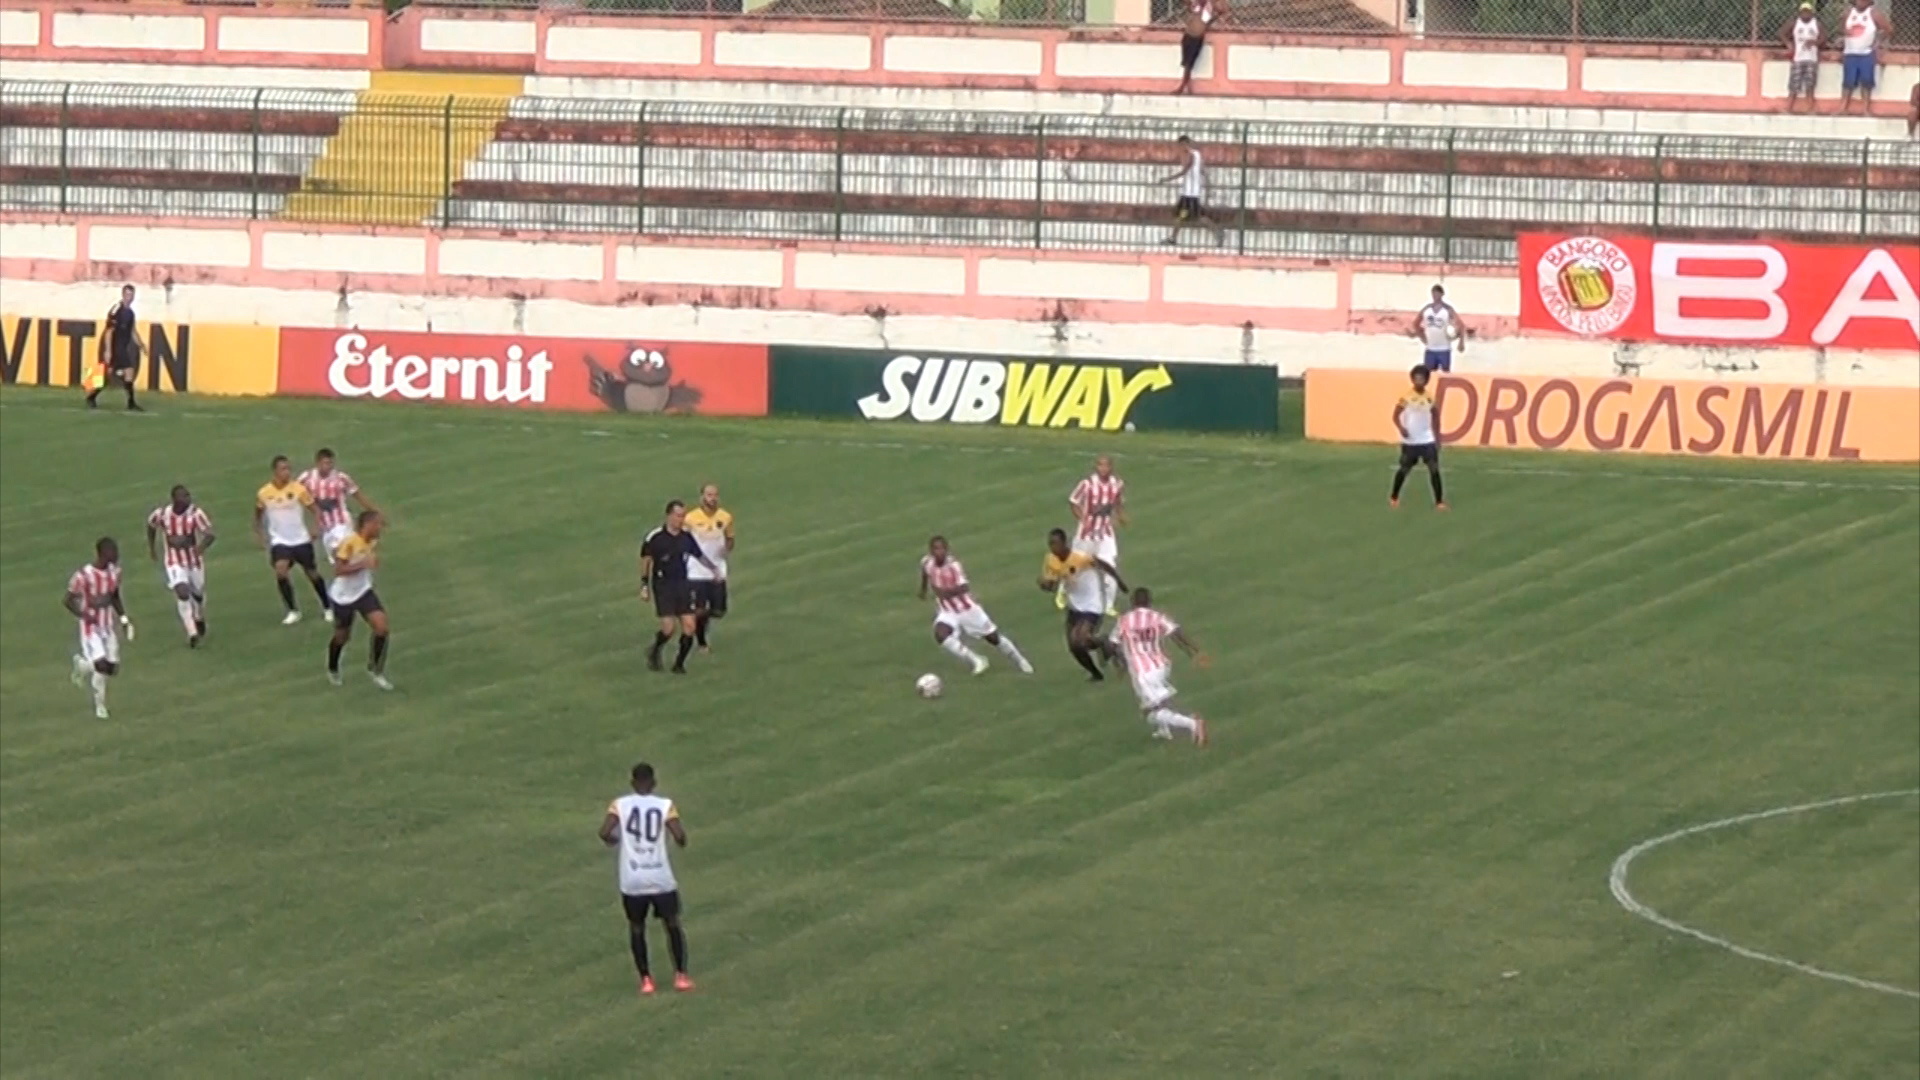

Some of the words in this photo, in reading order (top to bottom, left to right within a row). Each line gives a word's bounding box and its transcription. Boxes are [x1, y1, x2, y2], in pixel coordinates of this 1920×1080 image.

[1545, 239, 1627, 272] BANGORO
[328, 333, 552, 402] Eternit
[857, 356, 1173, 431] SUBWAY
[1434, 377, 1861, 459] DROGASMIL
[626, 806, 662, 843] 40
